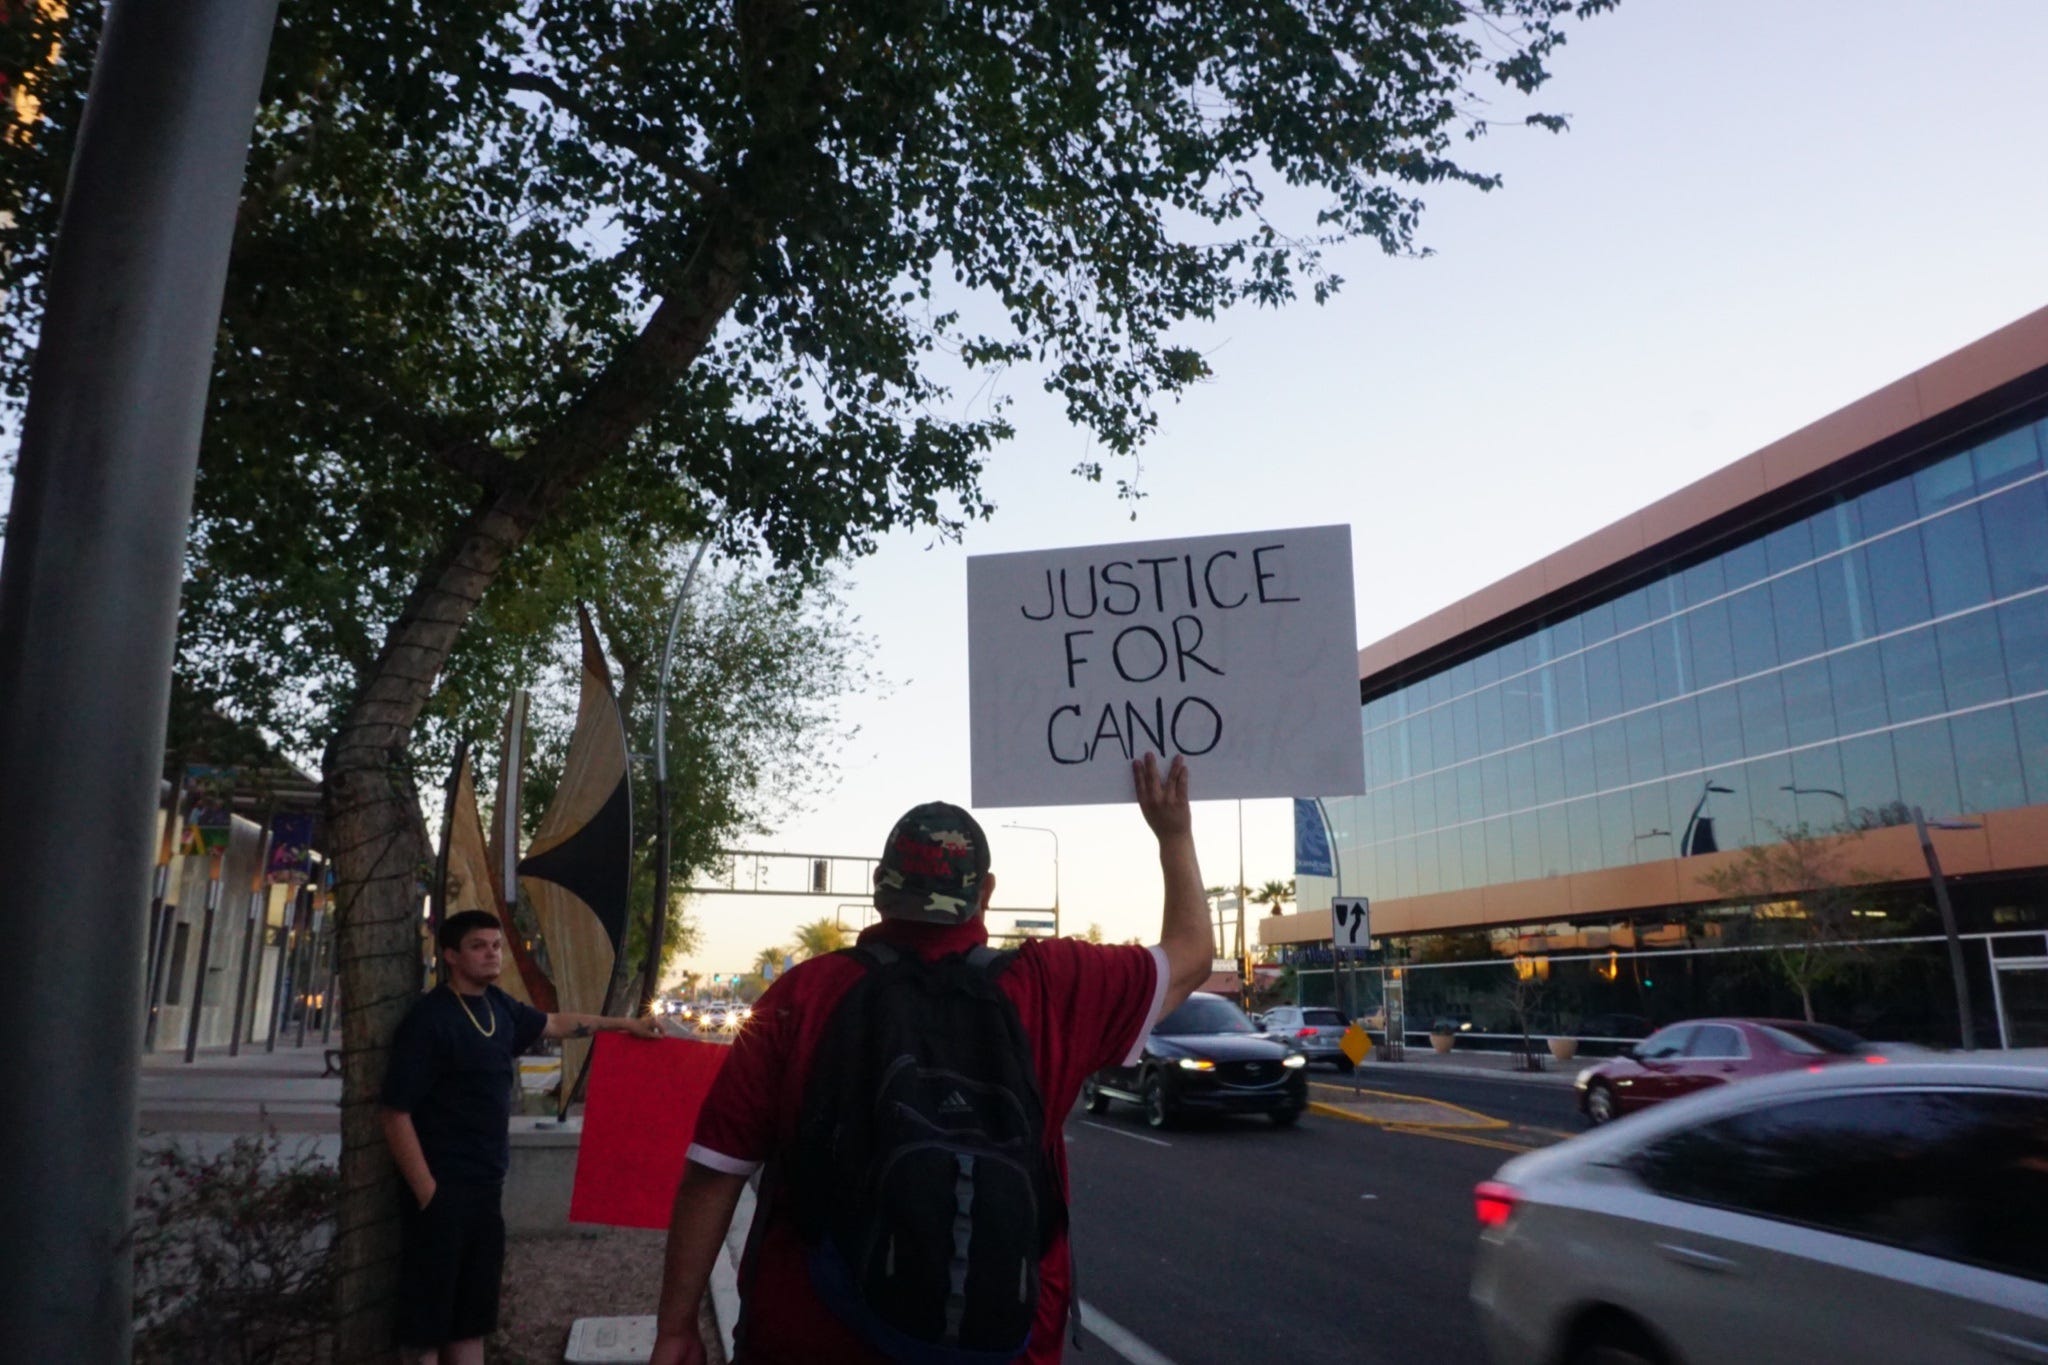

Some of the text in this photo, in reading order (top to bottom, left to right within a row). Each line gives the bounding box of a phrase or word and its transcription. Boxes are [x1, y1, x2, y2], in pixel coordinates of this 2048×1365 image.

[1021, 544, 1300, 621] JUSTICE
[1065, 615, 1225, 687] FOR
[1047, 696, 1223, 765] CANO
